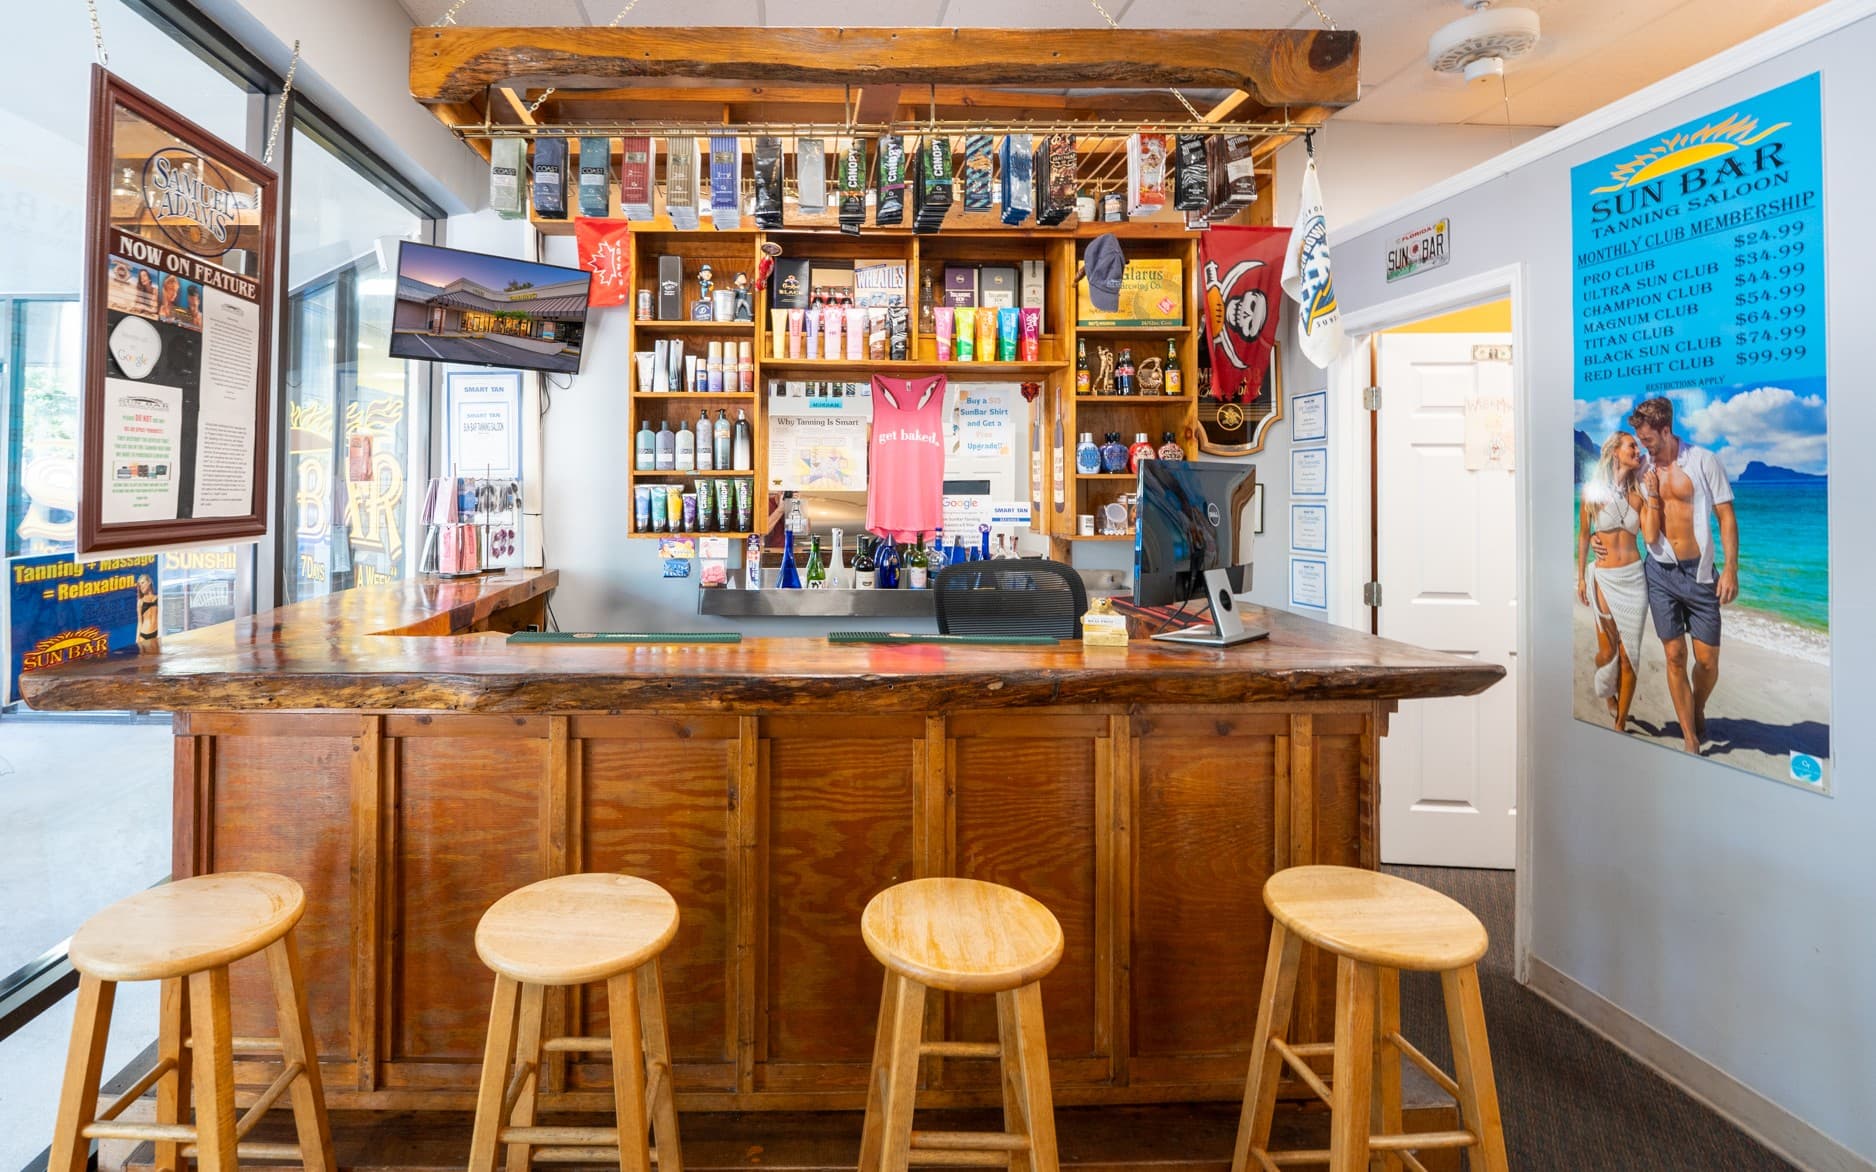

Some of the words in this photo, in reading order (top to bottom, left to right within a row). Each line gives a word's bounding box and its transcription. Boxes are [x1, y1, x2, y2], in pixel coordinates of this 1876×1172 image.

[848, 149, 858, 188] CANOPY
[931, 140, 943, 177] CANOPY
[153, 157, 235, 222] SAMUEL
[1591, 181, 1664, 225] SUN
[1679, 142, 1787, 196] BAR
[157, 190, 227, 243] ADAMS
[1592, 204, 1680, 240] TANNING
[1687, 170, 1789, 211] SALOON
[1402, 226, 1432, 241] FLORIDA
[1577, 235, 1642, 267] MONTHLY
[1645, 226, 1685, 249] CLUB
[1690, 190, 1815, 237] MEMBERSHIP
[119, 236, 163, 266] NOW
[166, 254, 191, 277] ON
[194, 263, 257, 300] FEATURE
[1388, 246, 1408, 271] SUN
[1422, 233, 1444, 260] BAR
[1583, 270, 1611, 286] PRO
[1615, 259, 1656, 278] CLUB
[1734, 220, 1804, 248] $24.99
[856, 266, 904, 288] WHEATIES
[1583, 282, 1631, 302] ULTRA
[1636, 273, 1667, 290] SUN
[1672, 262, 1719, 281] CLUB
[1735, 241, 1805, 267] $34.99
[1583, 292, 1662, 318] CHAMPION
[1667, 282, 1712, 300] CLUB
[1735, 262, 1805, 287] $44.99
[1584, 312, 1649, 334] MAGNUM
[1654, 303, 1699, 320] CLUB
[1735, 282, 1805, 306] $54.99
[1584, 333, 1628, 350] TITAN
[1632, 325, 1674, 341] CLUB
[1735, 303, 1806, 326] $64.99
[117, 348, 148, 367] Google
[1584, 349, 1634, 366] BLACK
[1639, 344, 1669, 358] SUN
[1675, 336, 1722, 352] CLUB
[1736, 324, 1806, 346] $74.99
[1584, 369, 1613, 382] RED
[1617, 362, 1664, 378] LIGHT
[1668, 355, 1714, 372] CLUB
[1736, 345, 1807, 366] $99.99
[966, 397, 980, 405] Buy
[1645, 379, 1697, 392] RESTRICTIONS
[1698, 375, 1725, 386] APPLY
[777, 418, 795, 426] Why
[797, 418, 826, 426] Tanning
[960, 408, 987, 416] SunBar
[879, 431, 897, 444] get
[901, 428, 940, 446] baked.
[943, 497, 978, 509] Google
[14, 560, 84, 584] Tanning
[99, 553, 156, 572] Massage
[58, 574, 138, 601] Relaxation.
[23, 652, 63, 671] SUN
[68, 637, 108, 659] BAR
